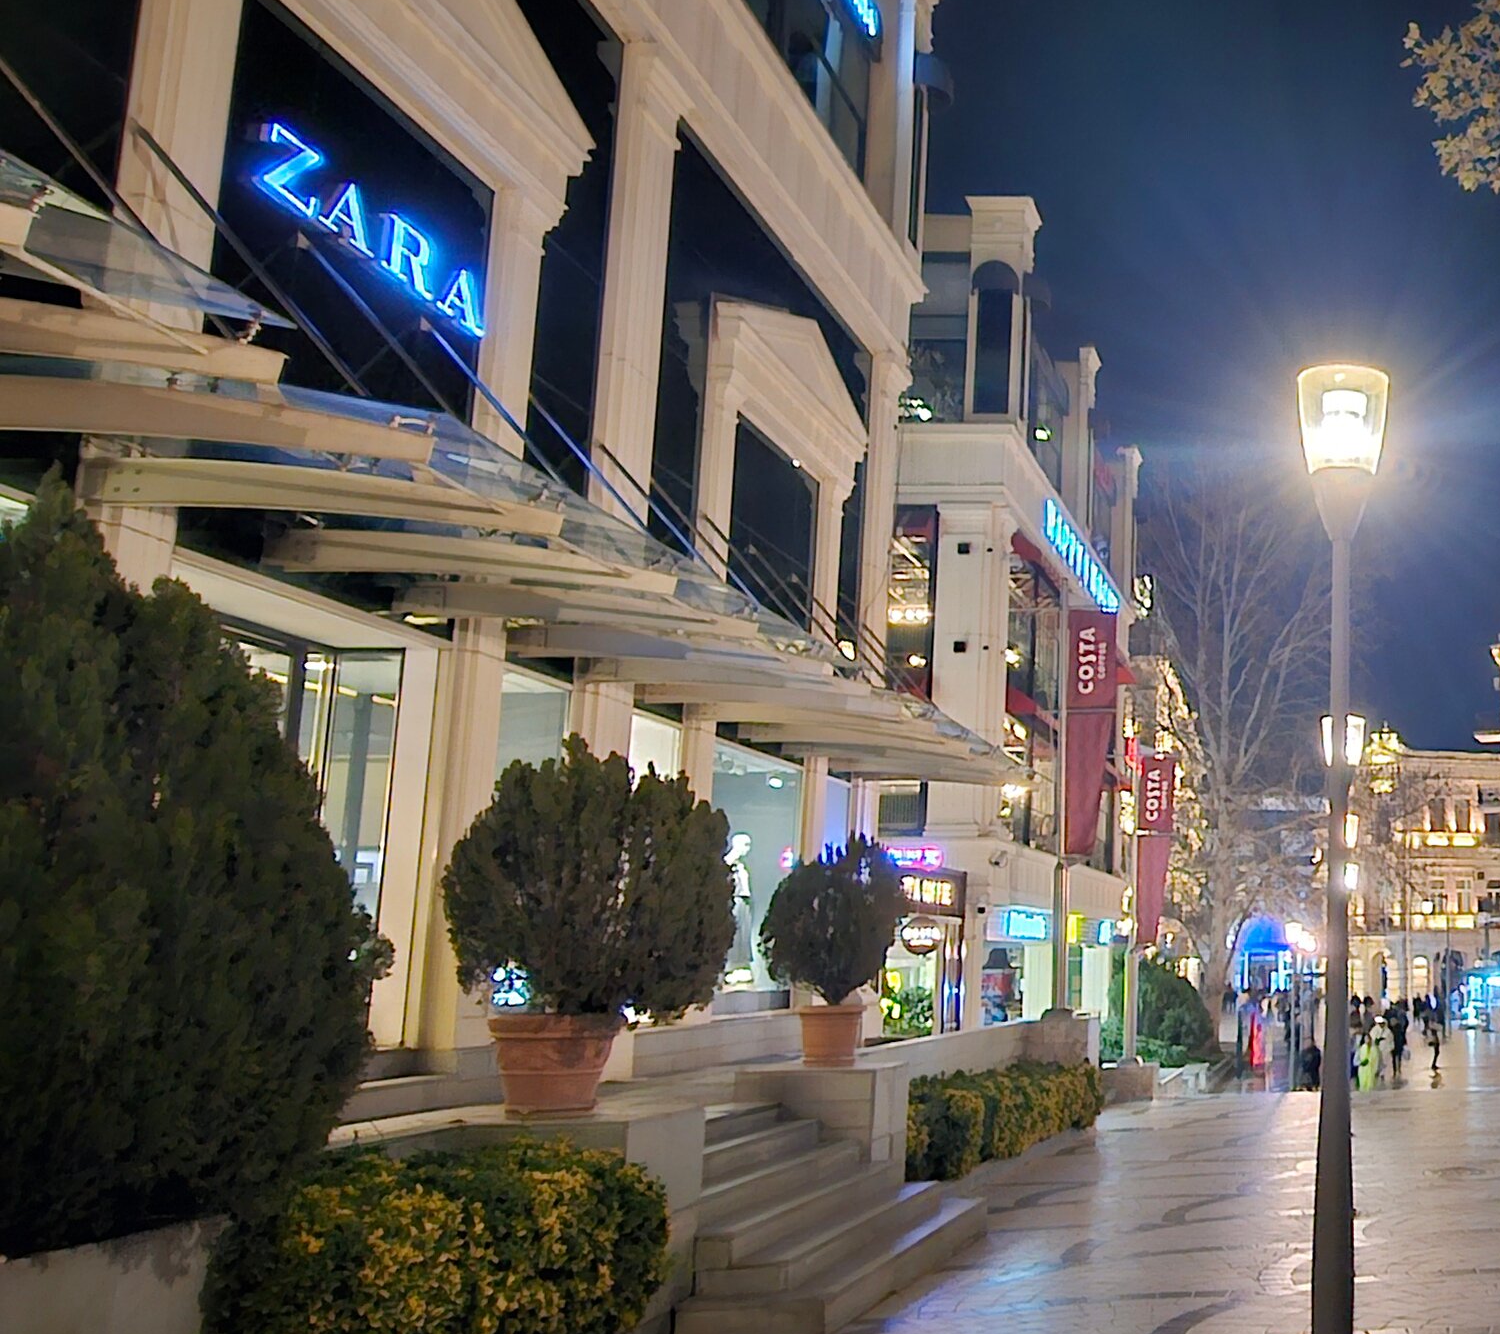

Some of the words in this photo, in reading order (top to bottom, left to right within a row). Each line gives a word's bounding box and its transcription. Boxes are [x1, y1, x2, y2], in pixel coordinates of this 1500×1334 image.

[260, 121, 487, 338] ZARA
[1078, 626, 1097, 695] COSTA
[1145, 769, 1161, 821] COSTA
